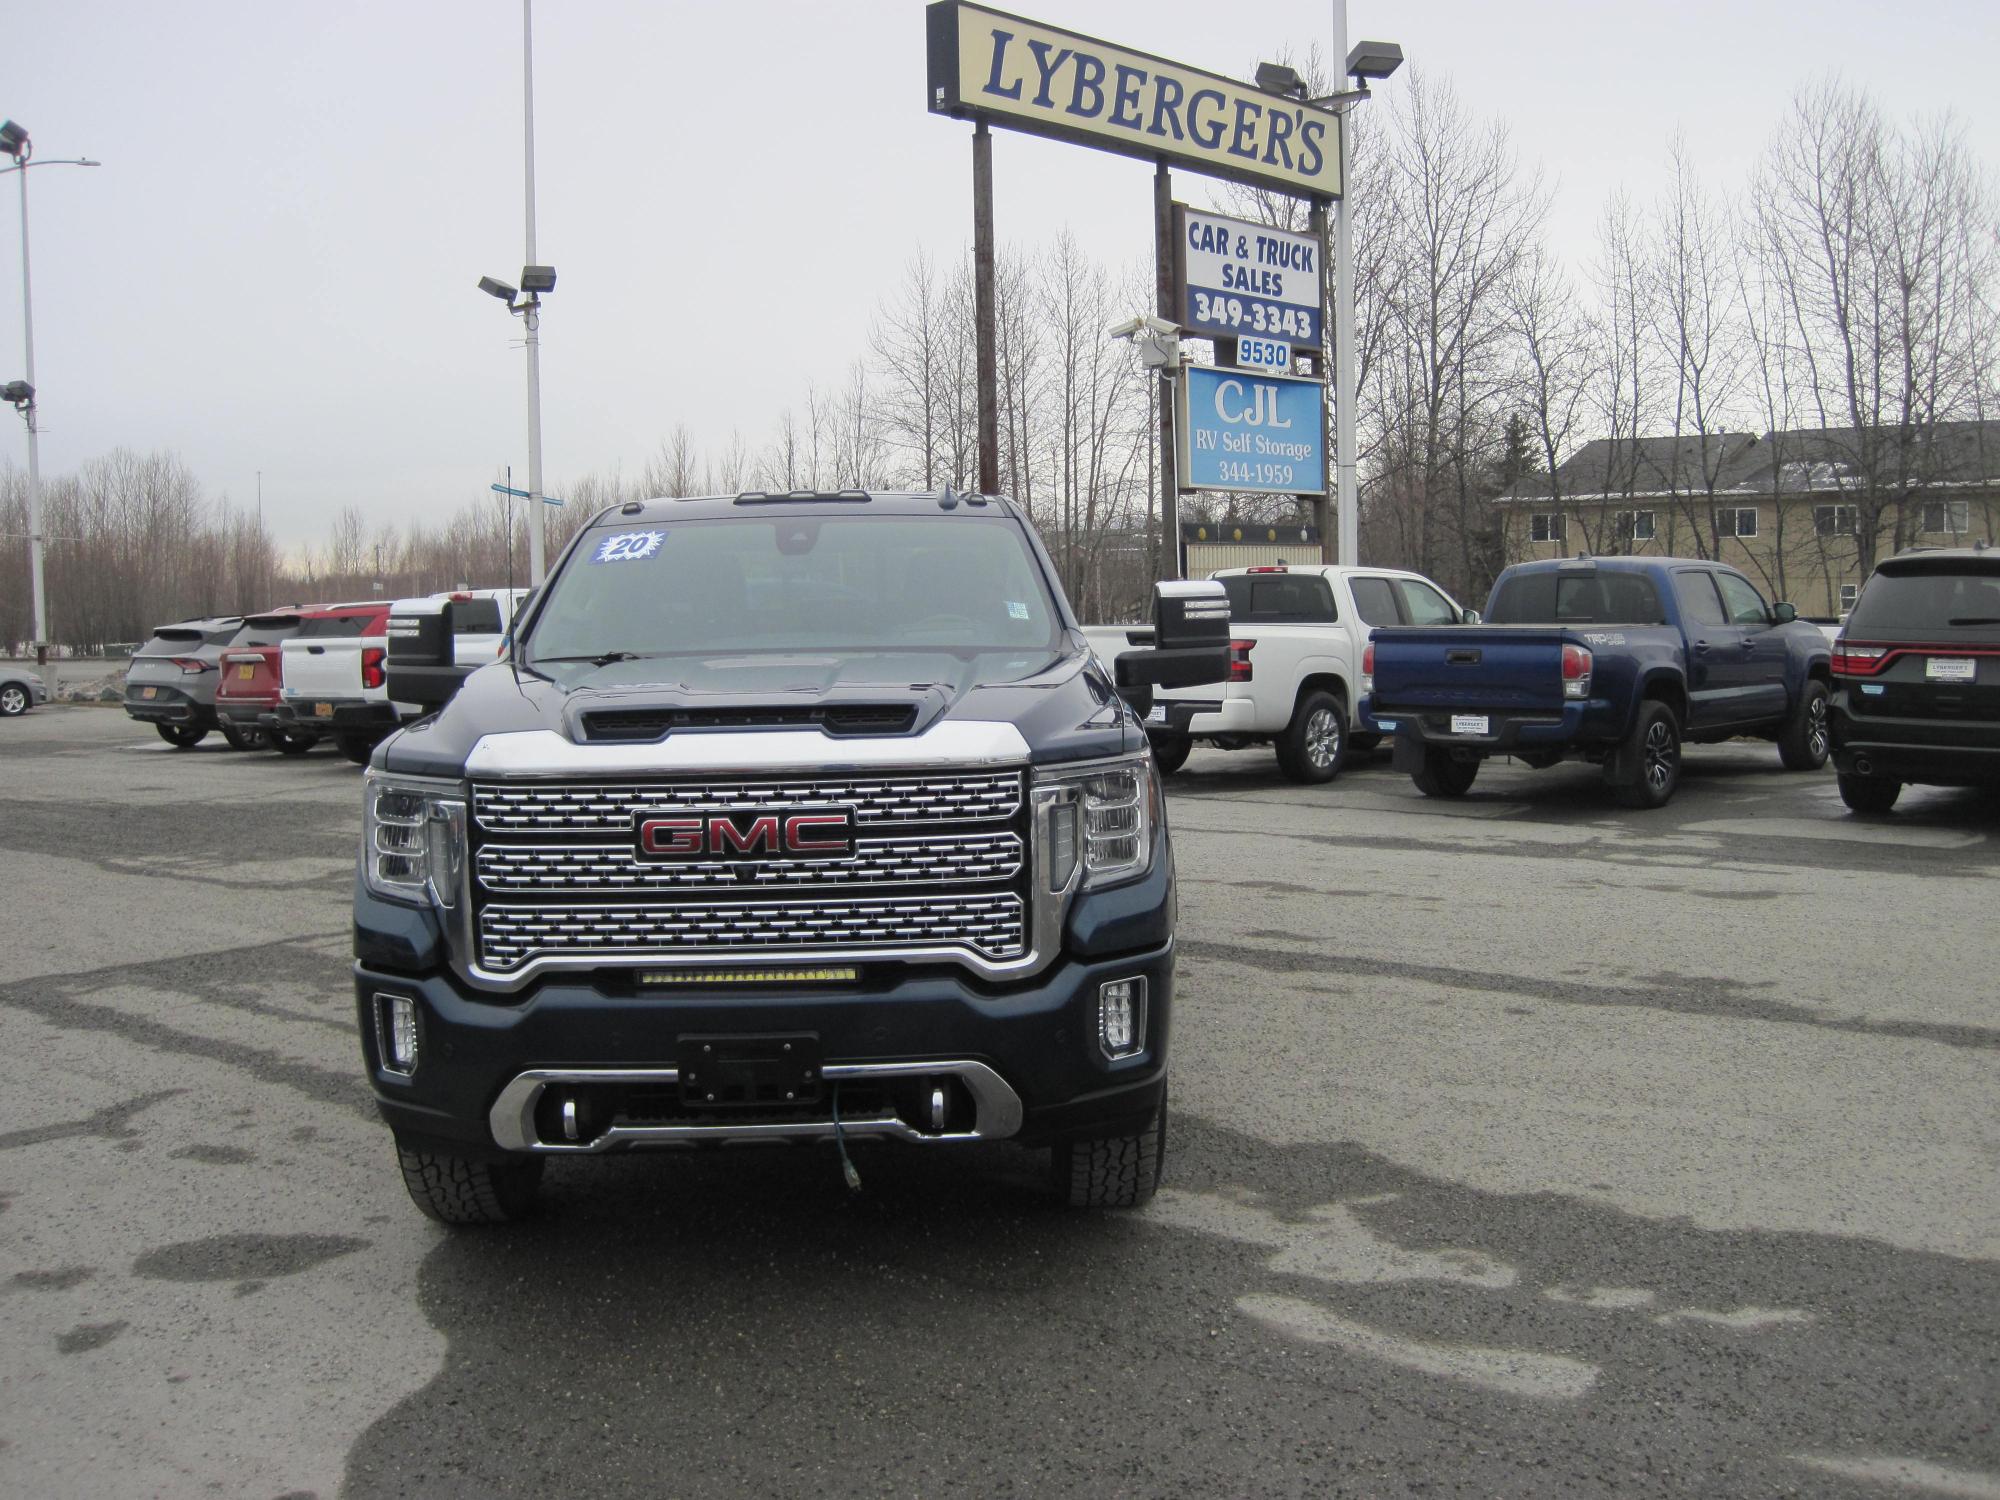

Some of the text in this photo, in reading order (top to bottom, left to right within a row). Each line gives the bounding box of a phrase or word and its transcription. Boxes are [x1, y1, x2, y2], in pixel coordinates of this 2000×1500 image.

[982, 28, 1325, 176] LYBERGER'S
[1188, 221, 1314, 273] CAR & TRUCK
[1222, 263, 1283, 297] SALES
[1194, 292, 1312, 339] 349-3343
[1240, 339, 1287, 366] 9530
[1214, 379, 1292, 428] CJL
[1196, 429, 1312, 461] RV Self Storage
[1219, 460, 1293, 485] 344-1959
[608, 536, 650, 555] 20
[641, 814, 849, 854] GMC
